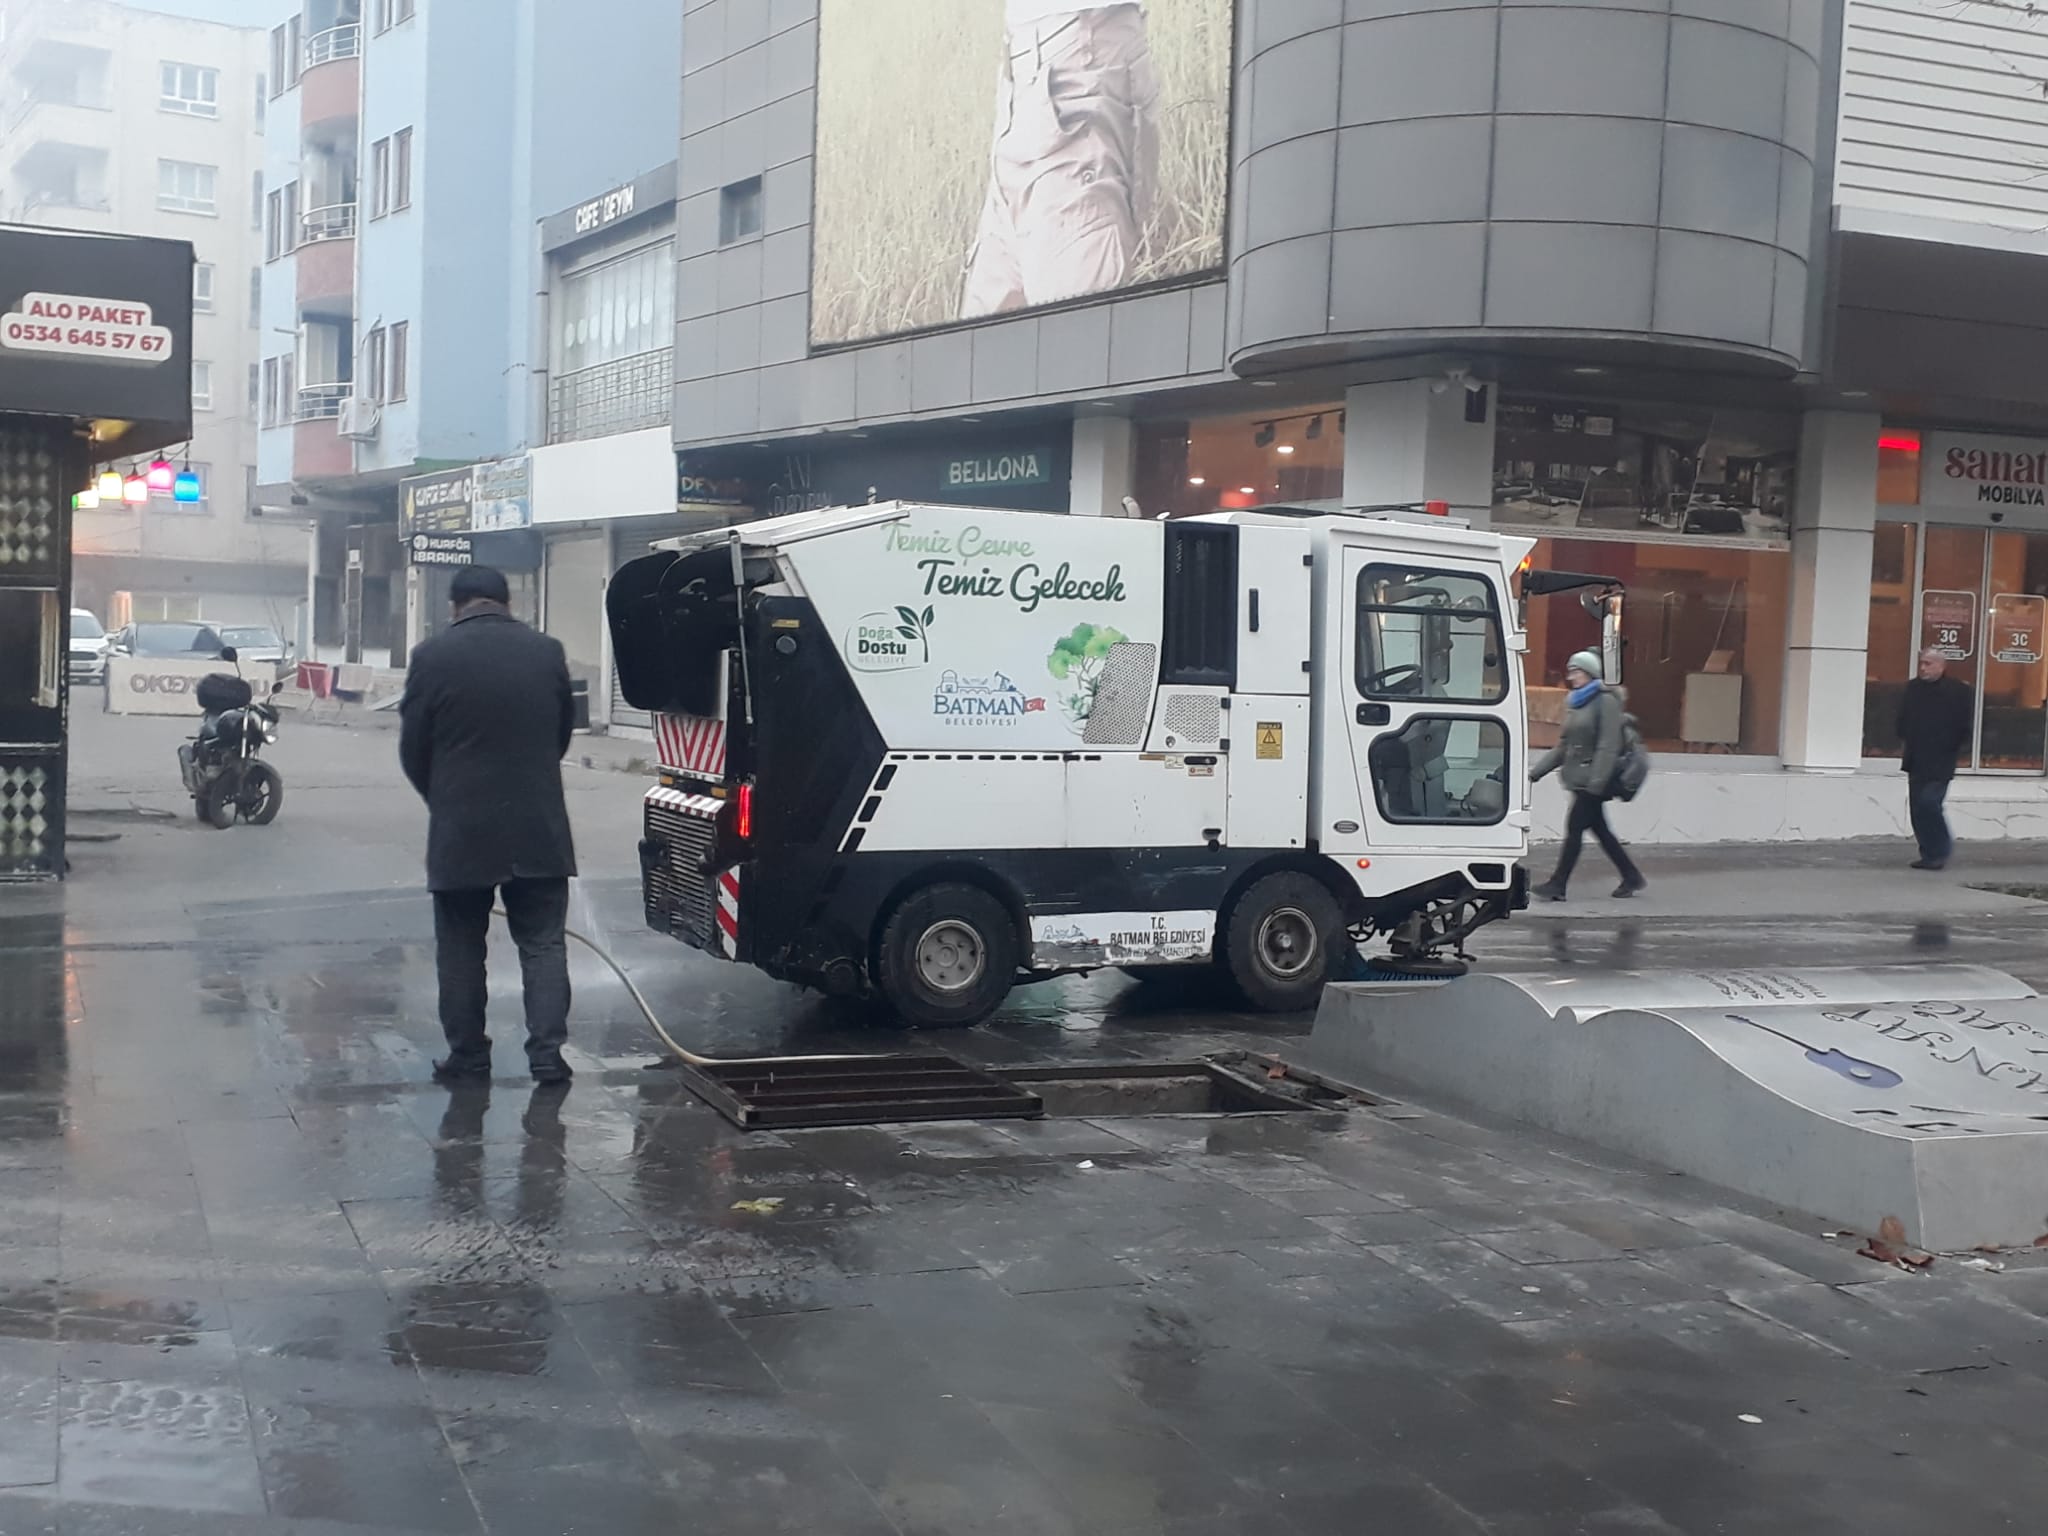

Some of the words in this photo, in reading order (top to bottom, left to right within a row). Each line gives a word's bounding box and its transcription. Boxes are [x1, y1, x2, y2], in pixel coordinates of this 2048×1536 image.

[29, 301, 73, 319] ALO
[78, 305, 146, 326] PAKET
[8, 323, 62, 343] 0534
[67, 329, 107, 347] 645
[111, 333, 135, 349] 57
[140, 335, 165, 351] 67
[949, 455, 1039, 484] BELLONA
[880, 522, 952, 554] Temiz
[957, 525, 1035, 566] Çevre
[917, 559, 1004, 596] Temiz
[1010, 562, 1127, 613] Gelecek
[858, 626, 894, 641] Doğa
[858, 639, 907, 655] Dostu
[933, 695, 1026, 716] BATMAN
[1150, 917, 1167, 930] T.C.
[1110, 931, 1151, 946] BATMAN
